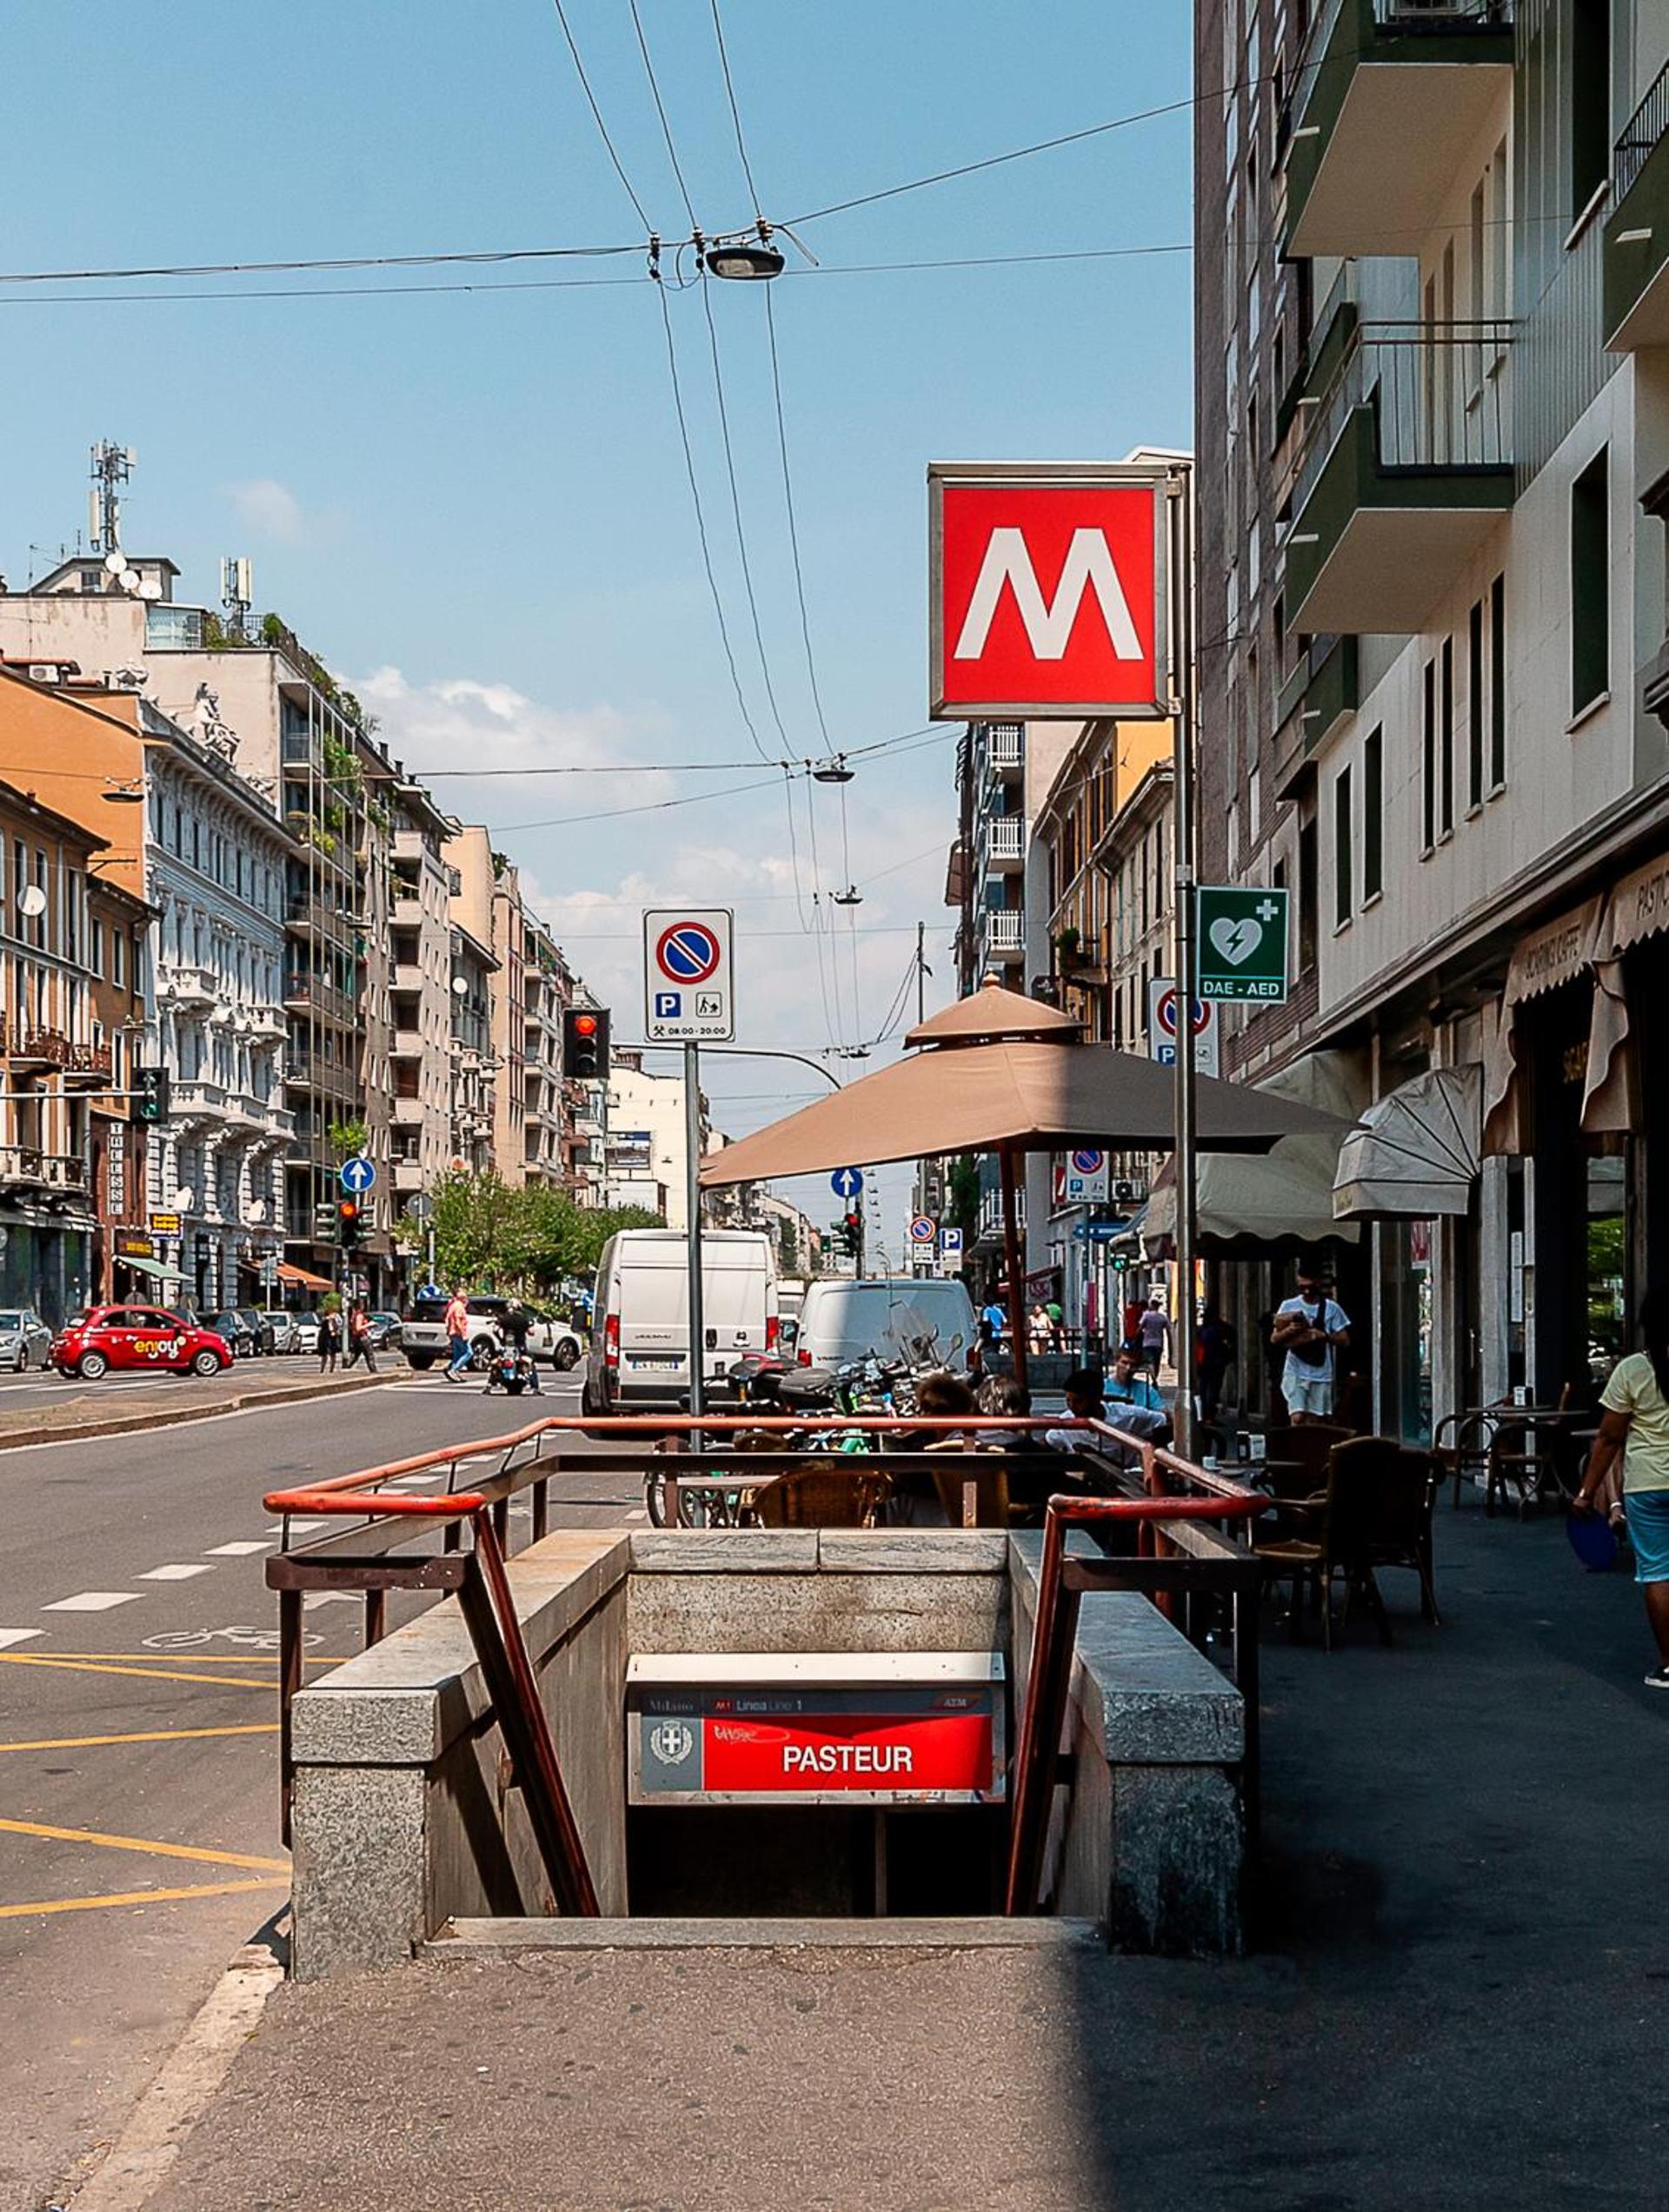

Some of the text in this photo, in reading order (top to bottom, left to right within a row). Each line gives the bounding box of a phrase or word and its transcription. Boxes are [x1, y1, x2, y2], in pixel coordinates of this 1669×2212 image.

[954, 527, 1144, 659] M
[1203, 981, 1233, 995] DAE
[1247, 983, 1279, 996] AED
[661, 996, 675, 1015] P
[945, 1229, 959, 1248] P
[134, 1340, 179, 1359] enjoy
[736, 1700, 768, 1711] Linea
[796, 1700, 802, 1711] 1
[783, 1745, 913, 1772] PASTEUR
